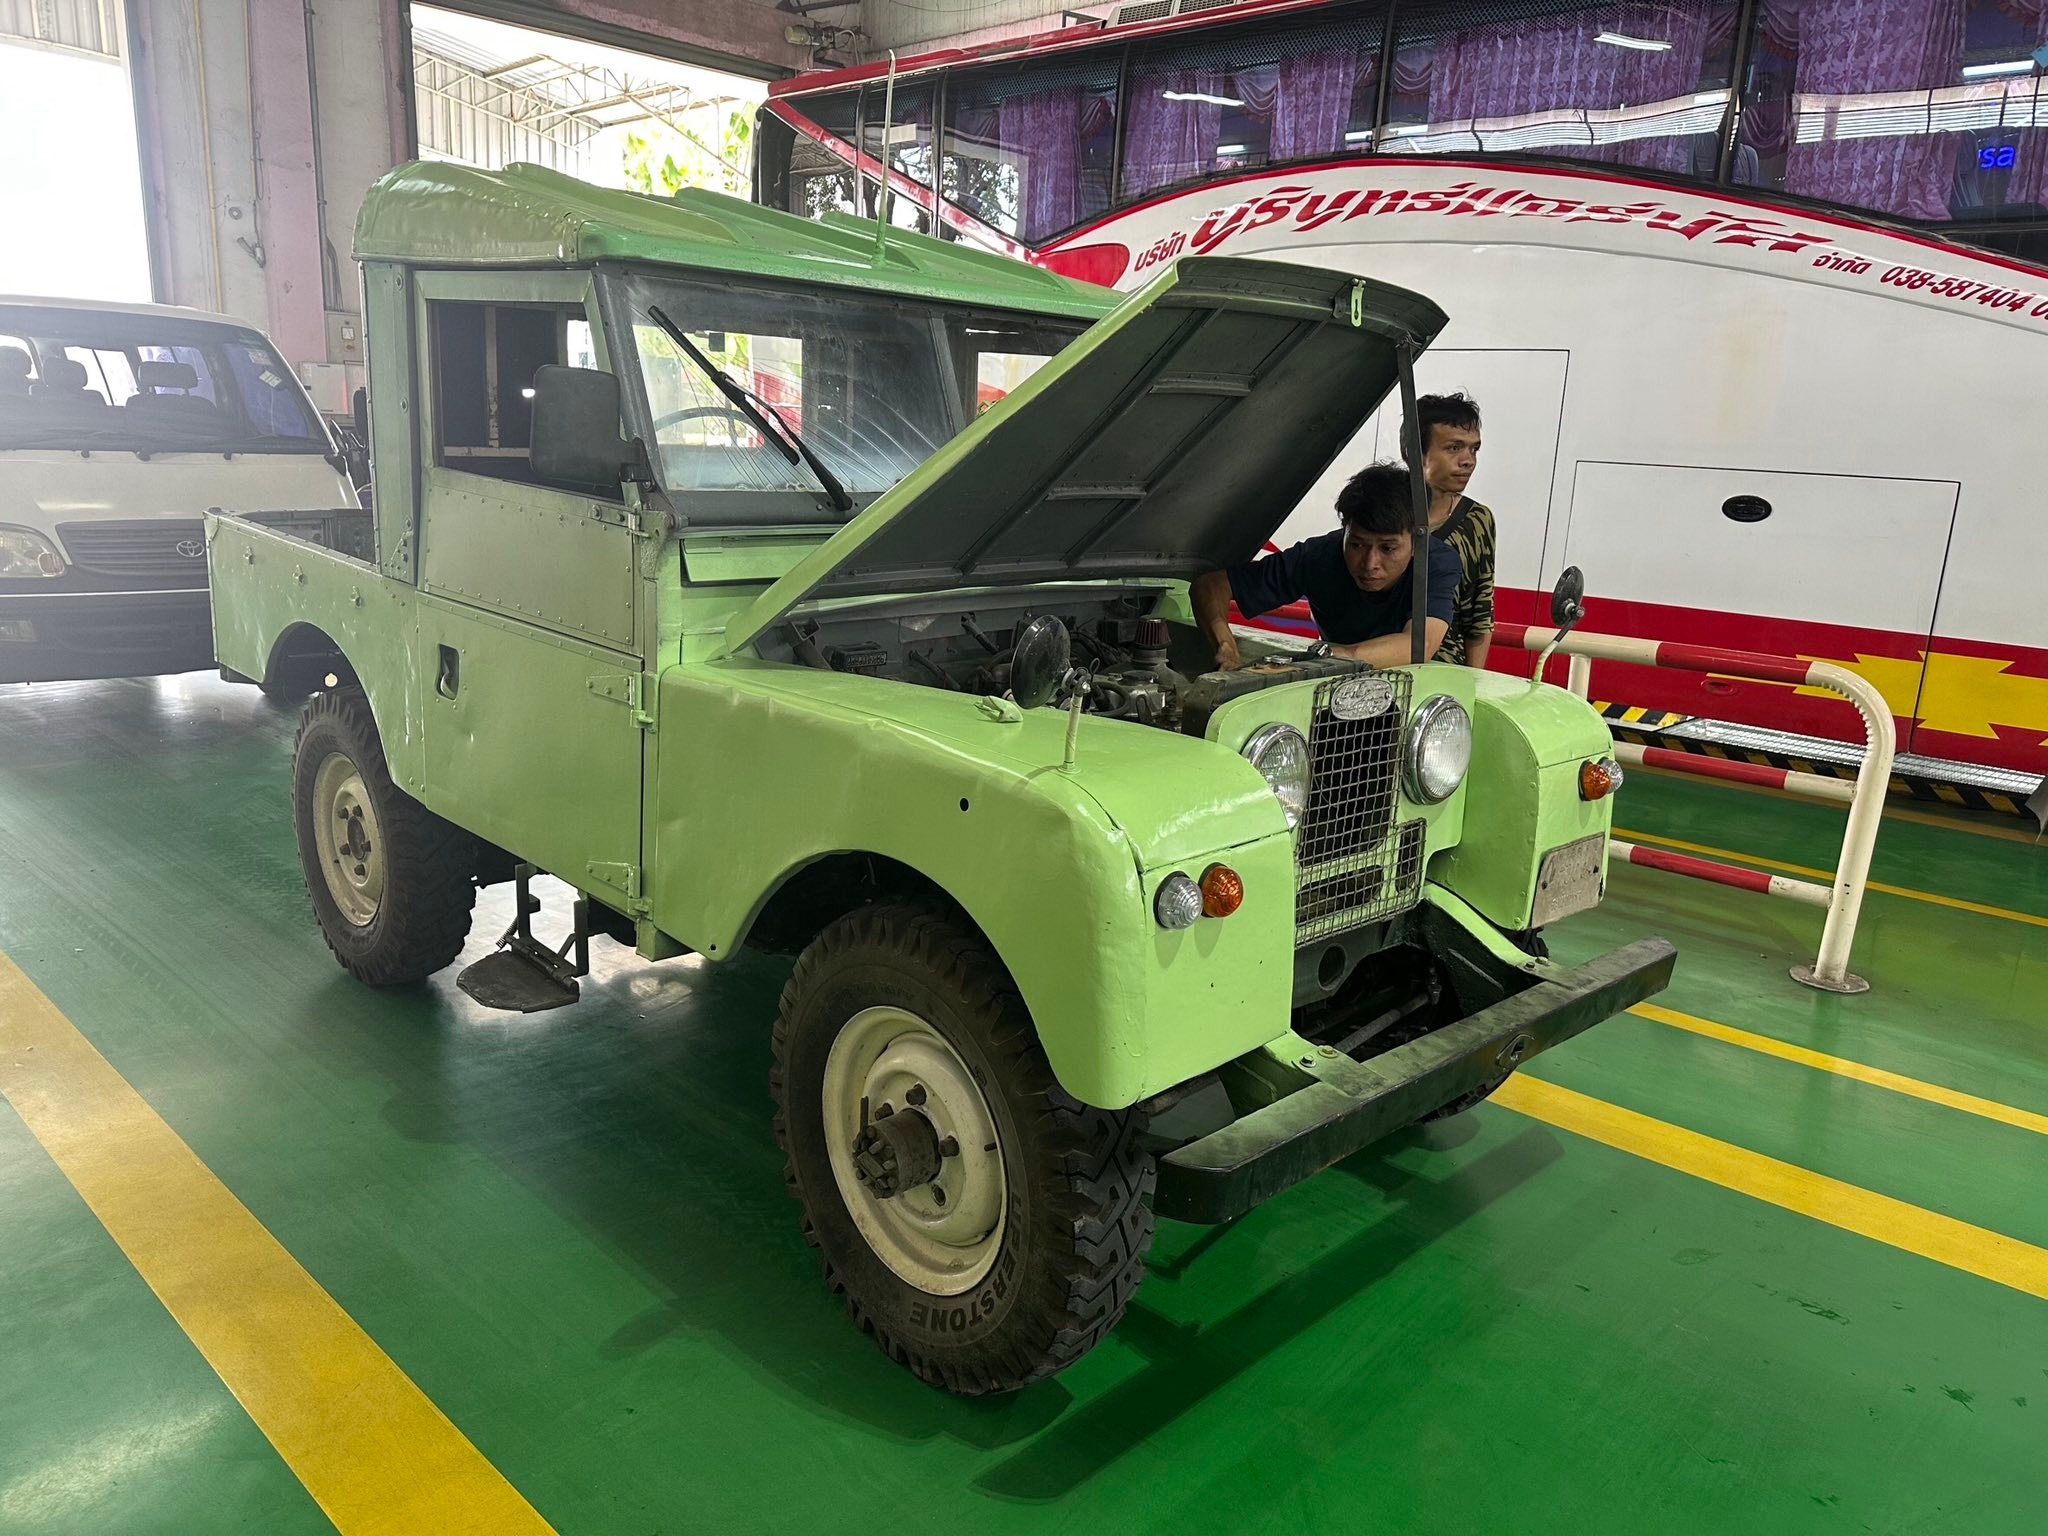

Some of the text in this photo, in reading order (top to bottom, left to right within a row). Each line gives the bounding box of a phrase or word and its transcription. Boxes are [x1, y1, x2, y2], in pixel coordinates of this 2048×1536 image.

[1134, 231, 1187, 272] บริษัท
[1812, 251, 1872, 275] จำกัด
[1880, 265, 2034, 312] 038-587404
